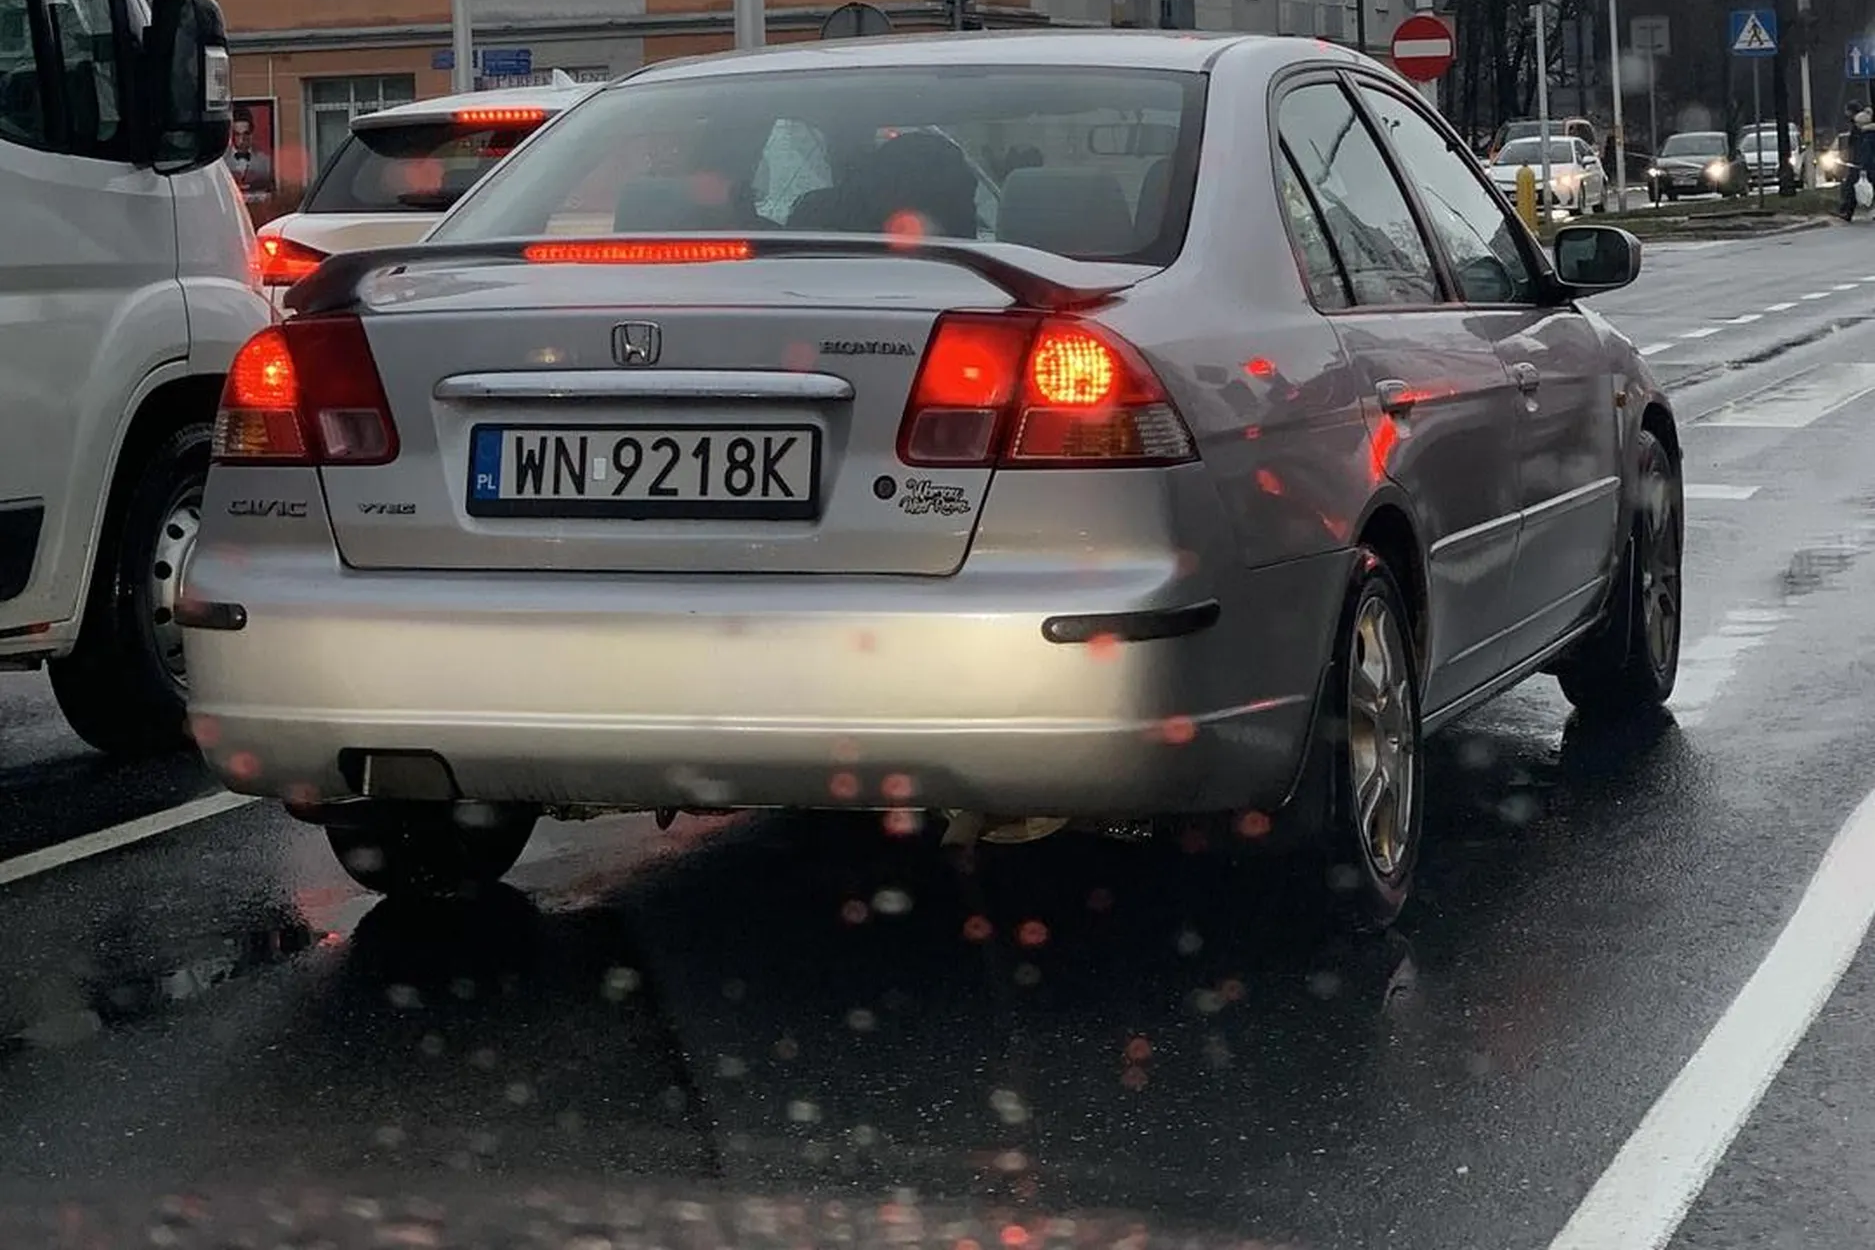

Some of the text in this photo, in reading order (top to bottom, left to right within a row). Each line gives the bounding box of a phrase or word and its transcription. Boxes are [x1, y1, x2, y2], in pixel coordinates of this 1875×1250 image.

[819, 341, 916, 356] HONDA
[515, 435, 798, 498] WN 9218K
[476, 473, 497, 490] PL
[228, 500, 307, 518] CIVIC
[358, 502, 416, 515] VTEC
